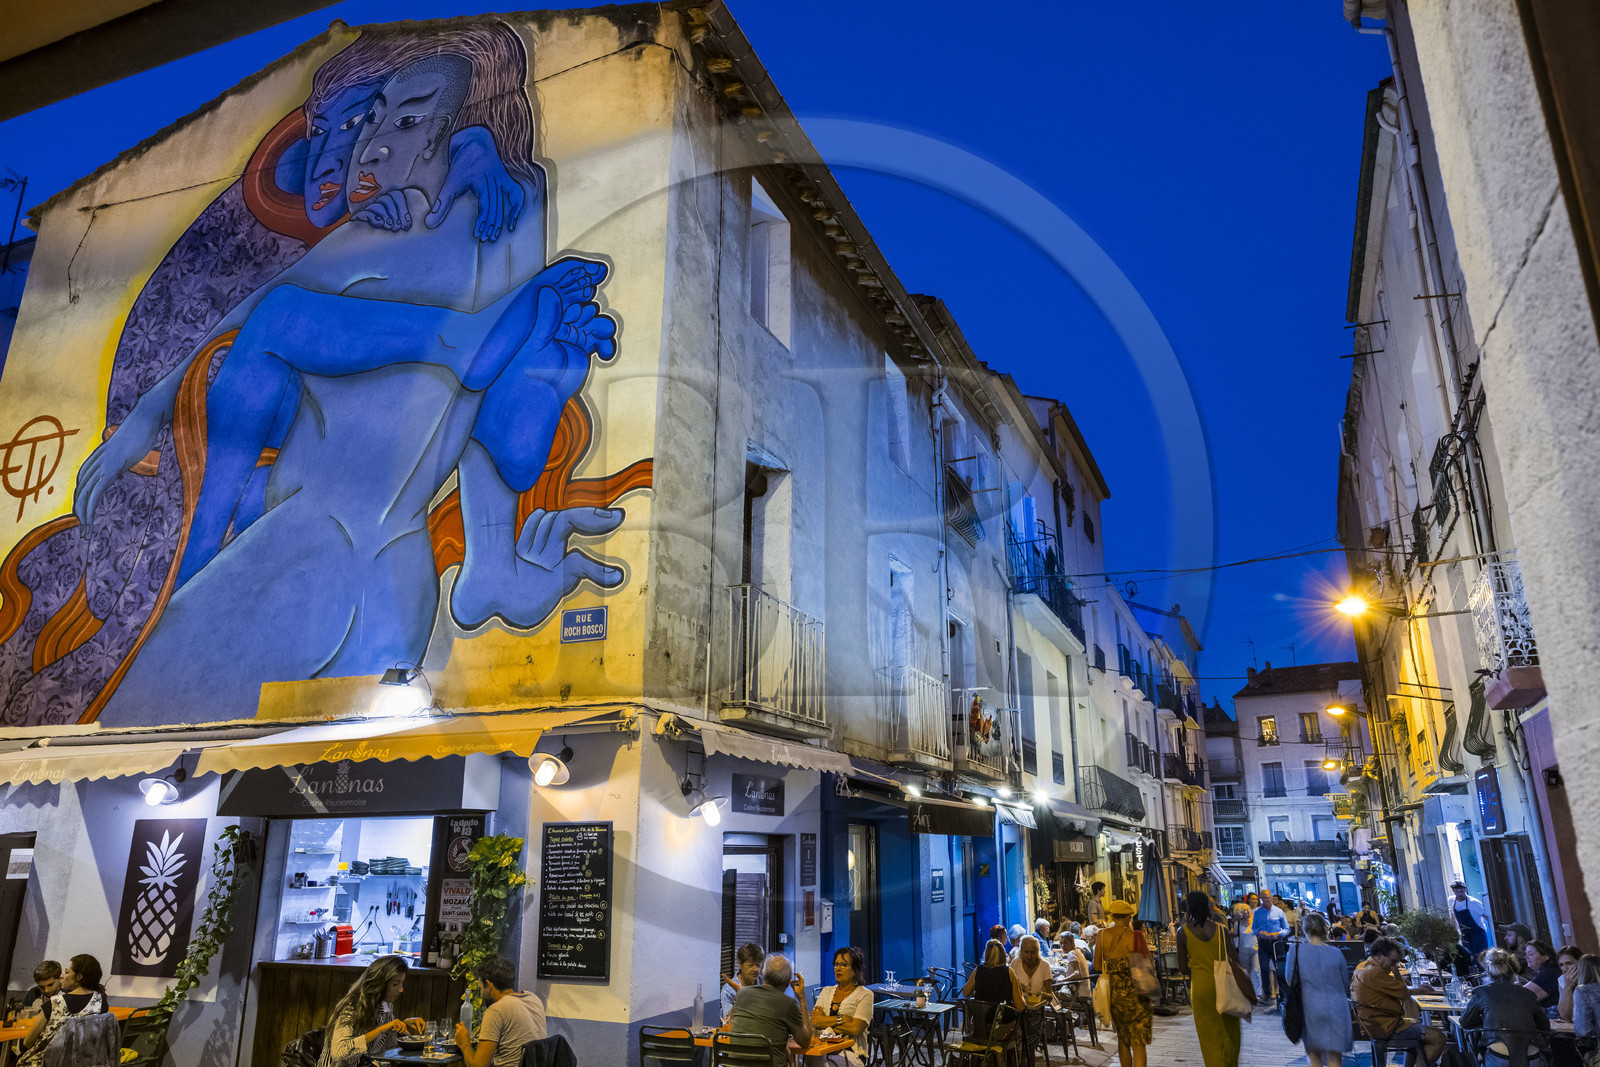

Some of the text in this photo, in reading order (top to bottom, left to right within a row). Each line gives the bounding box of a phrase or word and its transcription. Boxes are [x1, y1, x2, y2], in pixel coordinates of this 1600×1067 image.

[575, 613, 592, 623] RUE
[563, 623, 604, 637] ROCH BOSCO
[436, 744, 463, 753] Cuisine
[463, 742, 513, 752] Réunionnaise
[301, 798, 367, 807] Cuisine Réunionnaise
